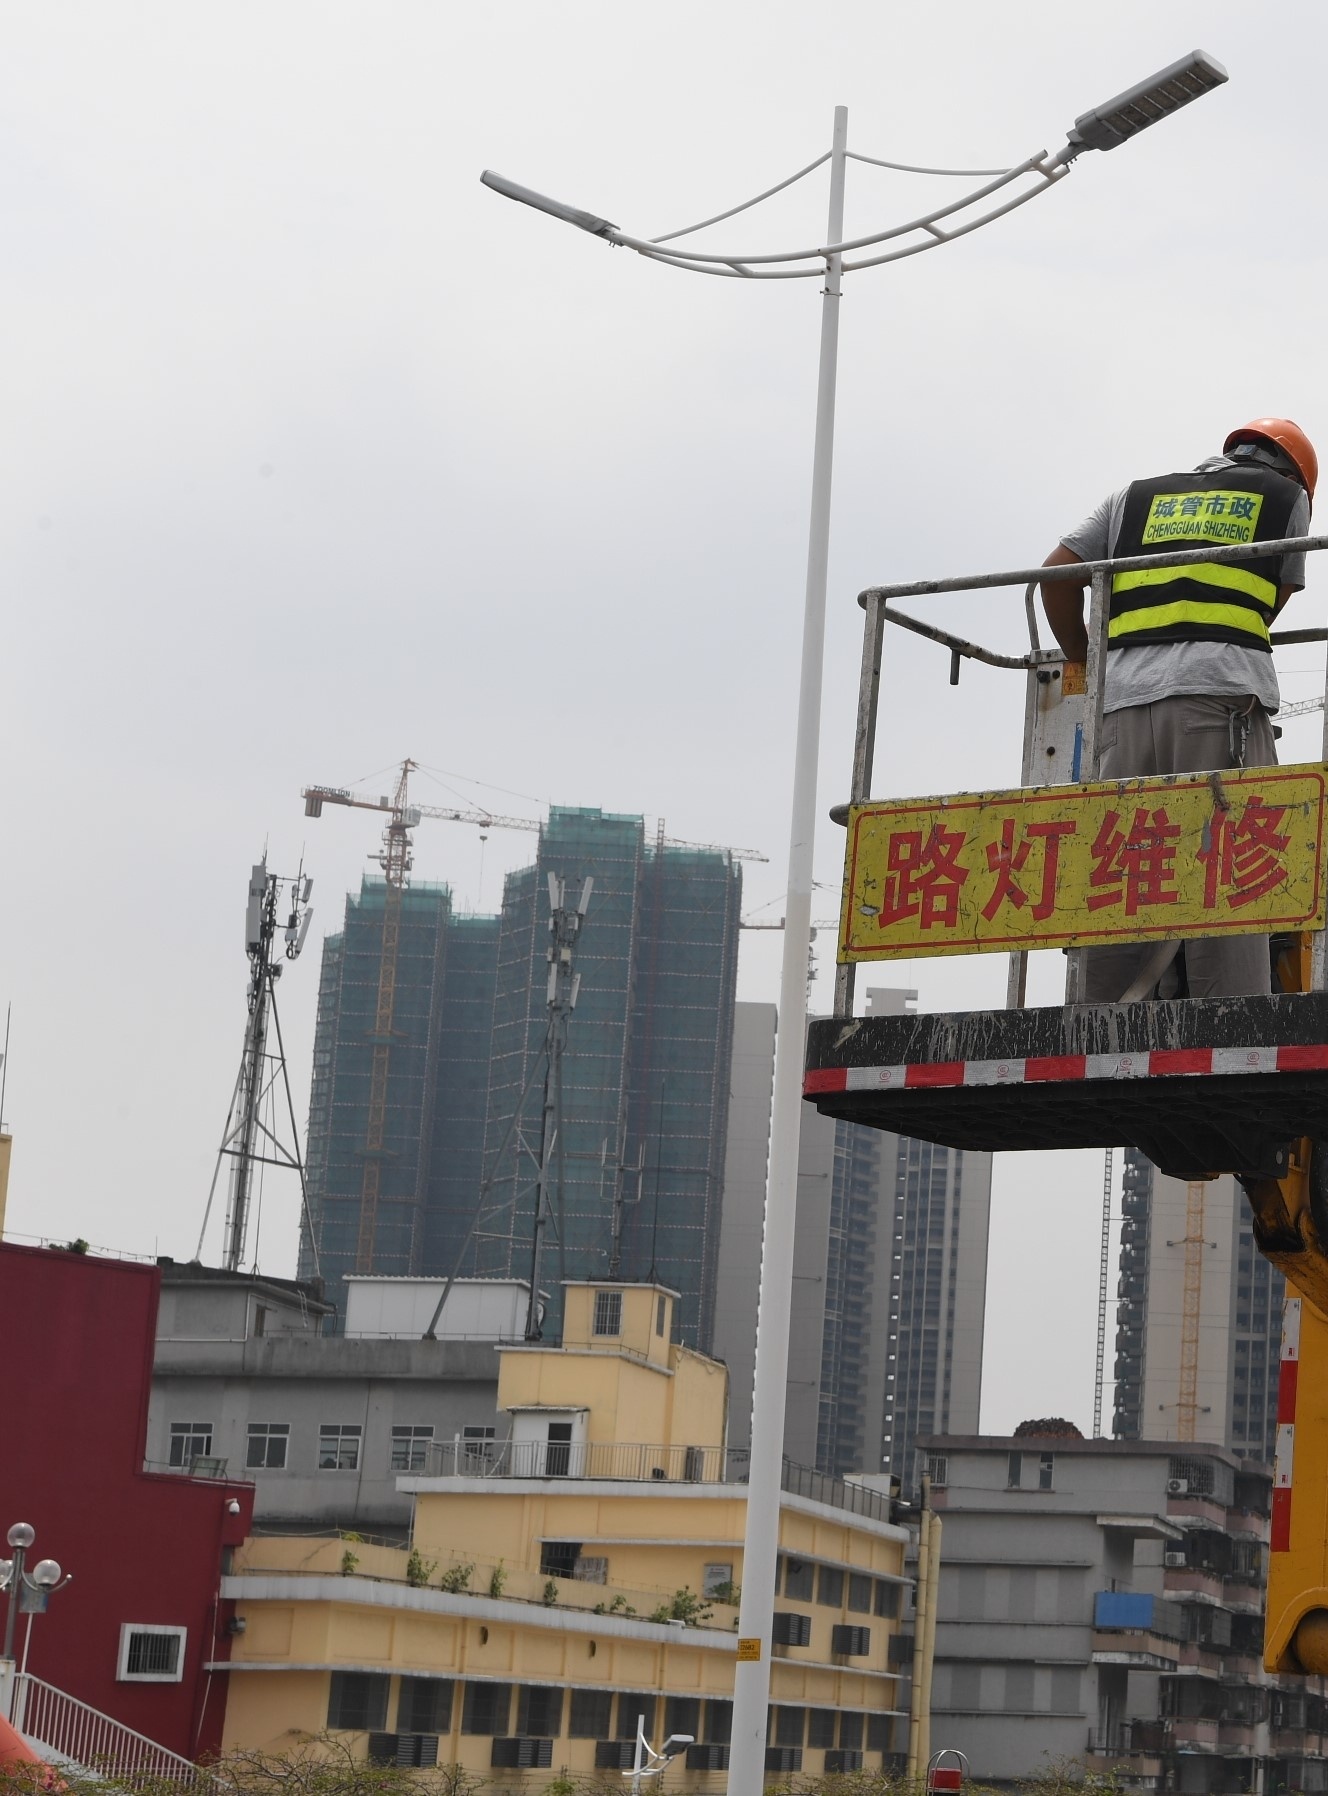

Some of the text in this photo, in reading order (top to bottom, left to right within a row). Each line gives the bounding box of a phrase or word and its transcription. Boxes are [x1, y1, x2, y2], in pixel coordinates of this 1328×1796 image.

[1153, 495, 1256, 521] 城管市政
[1147, 520, 1249, 542] CHENGGUAN SHIZHENG
[878, 796, 1292, 930] 路灯维修
